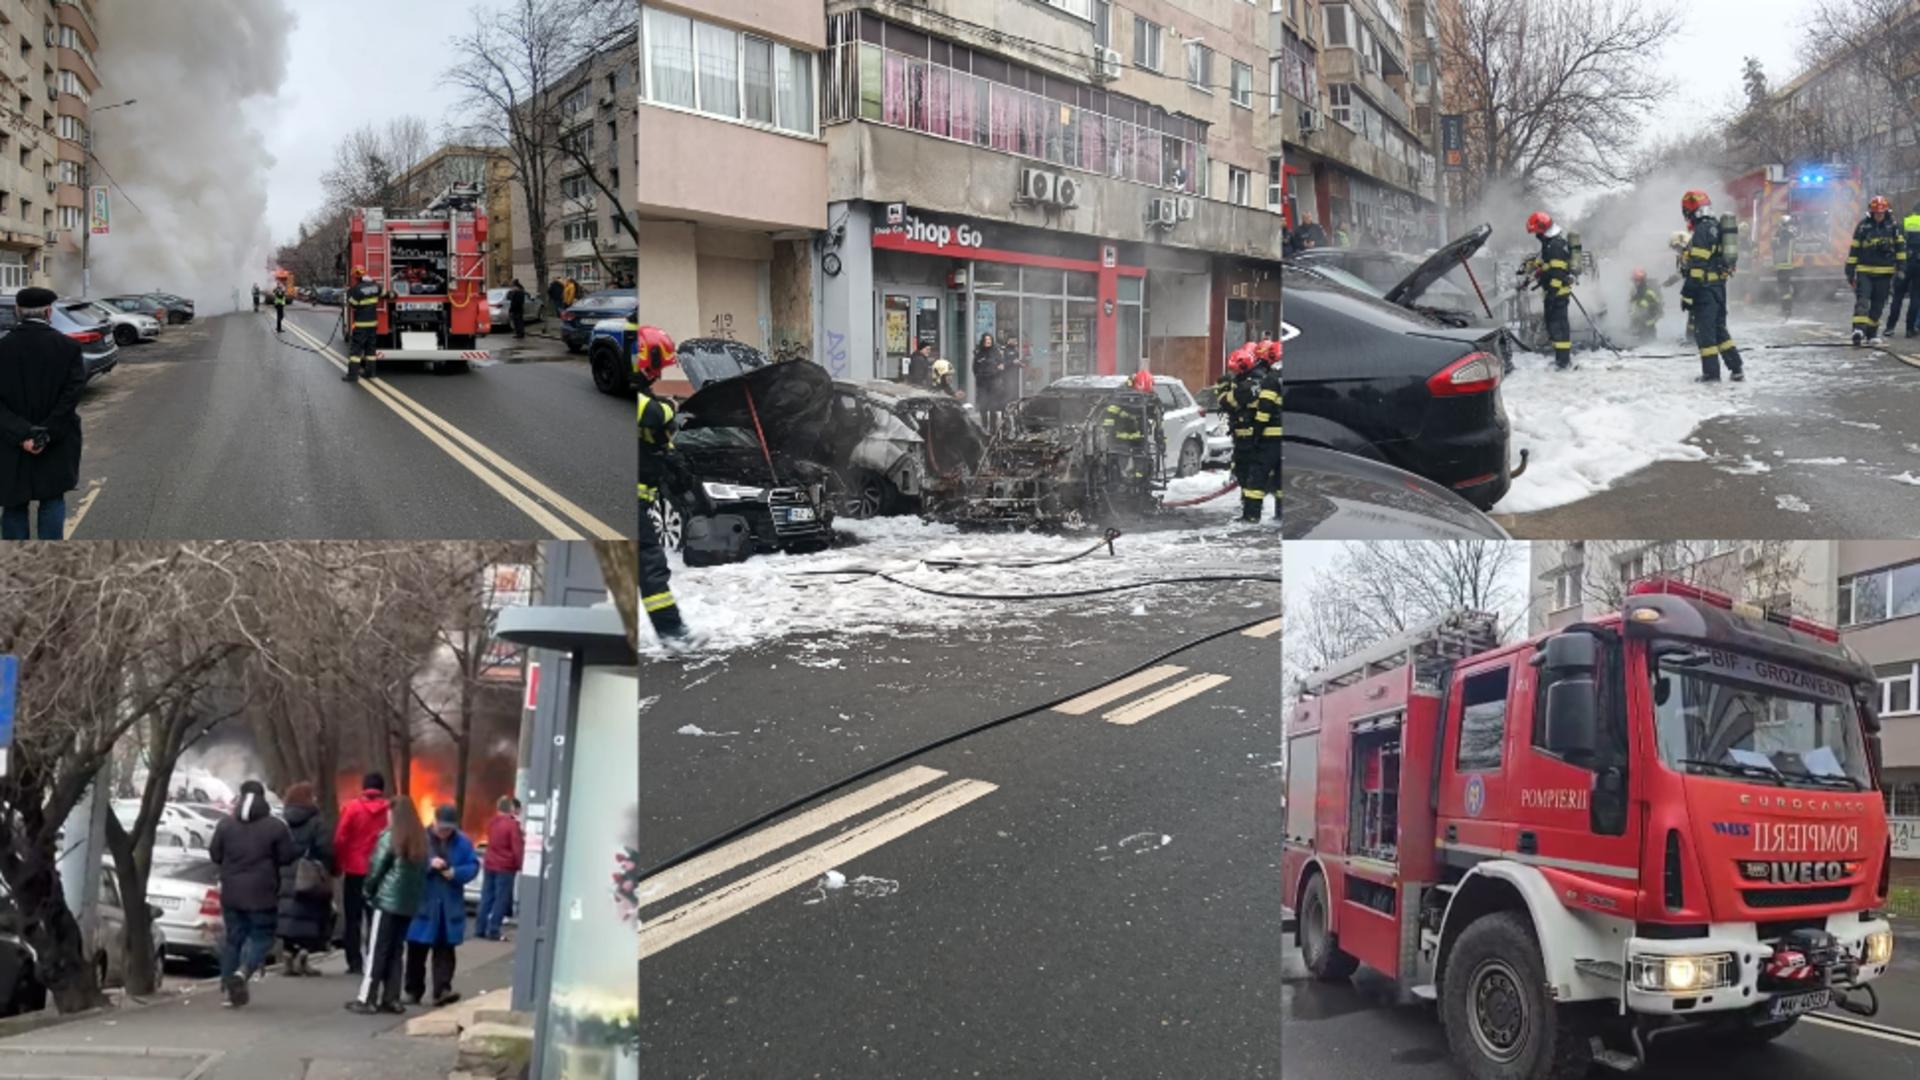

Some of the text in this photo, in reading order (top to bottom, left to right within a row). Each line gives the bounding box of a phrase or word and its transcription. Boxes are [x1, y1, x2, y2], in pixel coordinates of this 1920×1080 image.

[957, 224, 982, 248] Go
[1521, 788, 1588, 809] POMPIERII
[1770, 861, 1842, 884] IVECO
